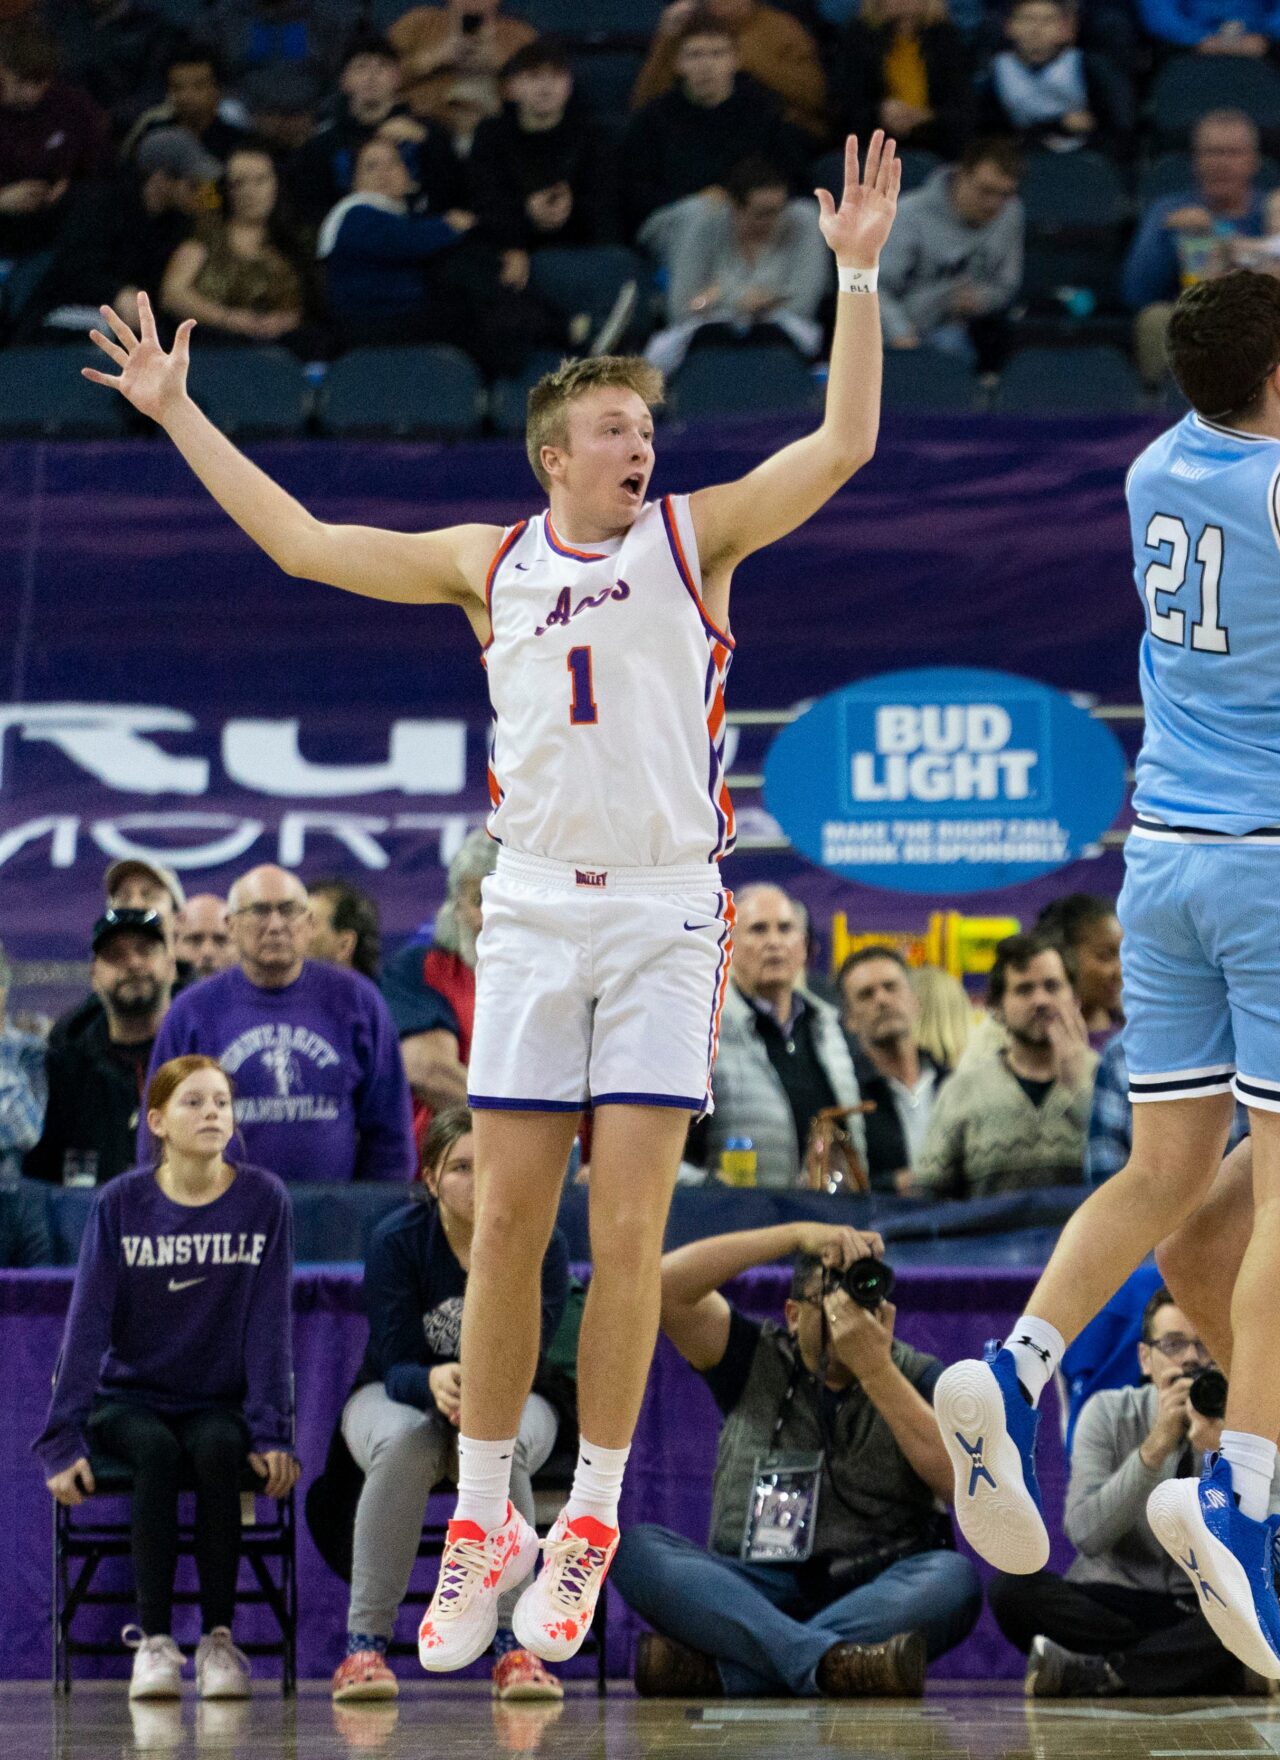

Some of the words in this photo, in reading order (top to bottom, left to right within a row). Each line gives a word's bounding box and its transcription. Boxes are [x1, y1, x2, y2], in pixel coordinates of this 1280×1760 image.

[1144, 511, 1231, 655] 21
[567, 645, 599, 725] 1
[0, 703, 467, 797] RU
[876, 703, 1012, 754] BUD
[851, 750, 1038, 802] LIGHT
[0, 811, 492, 871] ORT
[892, 821, 931, 841] THE
[233, 1096, 339, 1122] VANSVILLE
[121, 1232, 267, 1267] VANSVILLE
